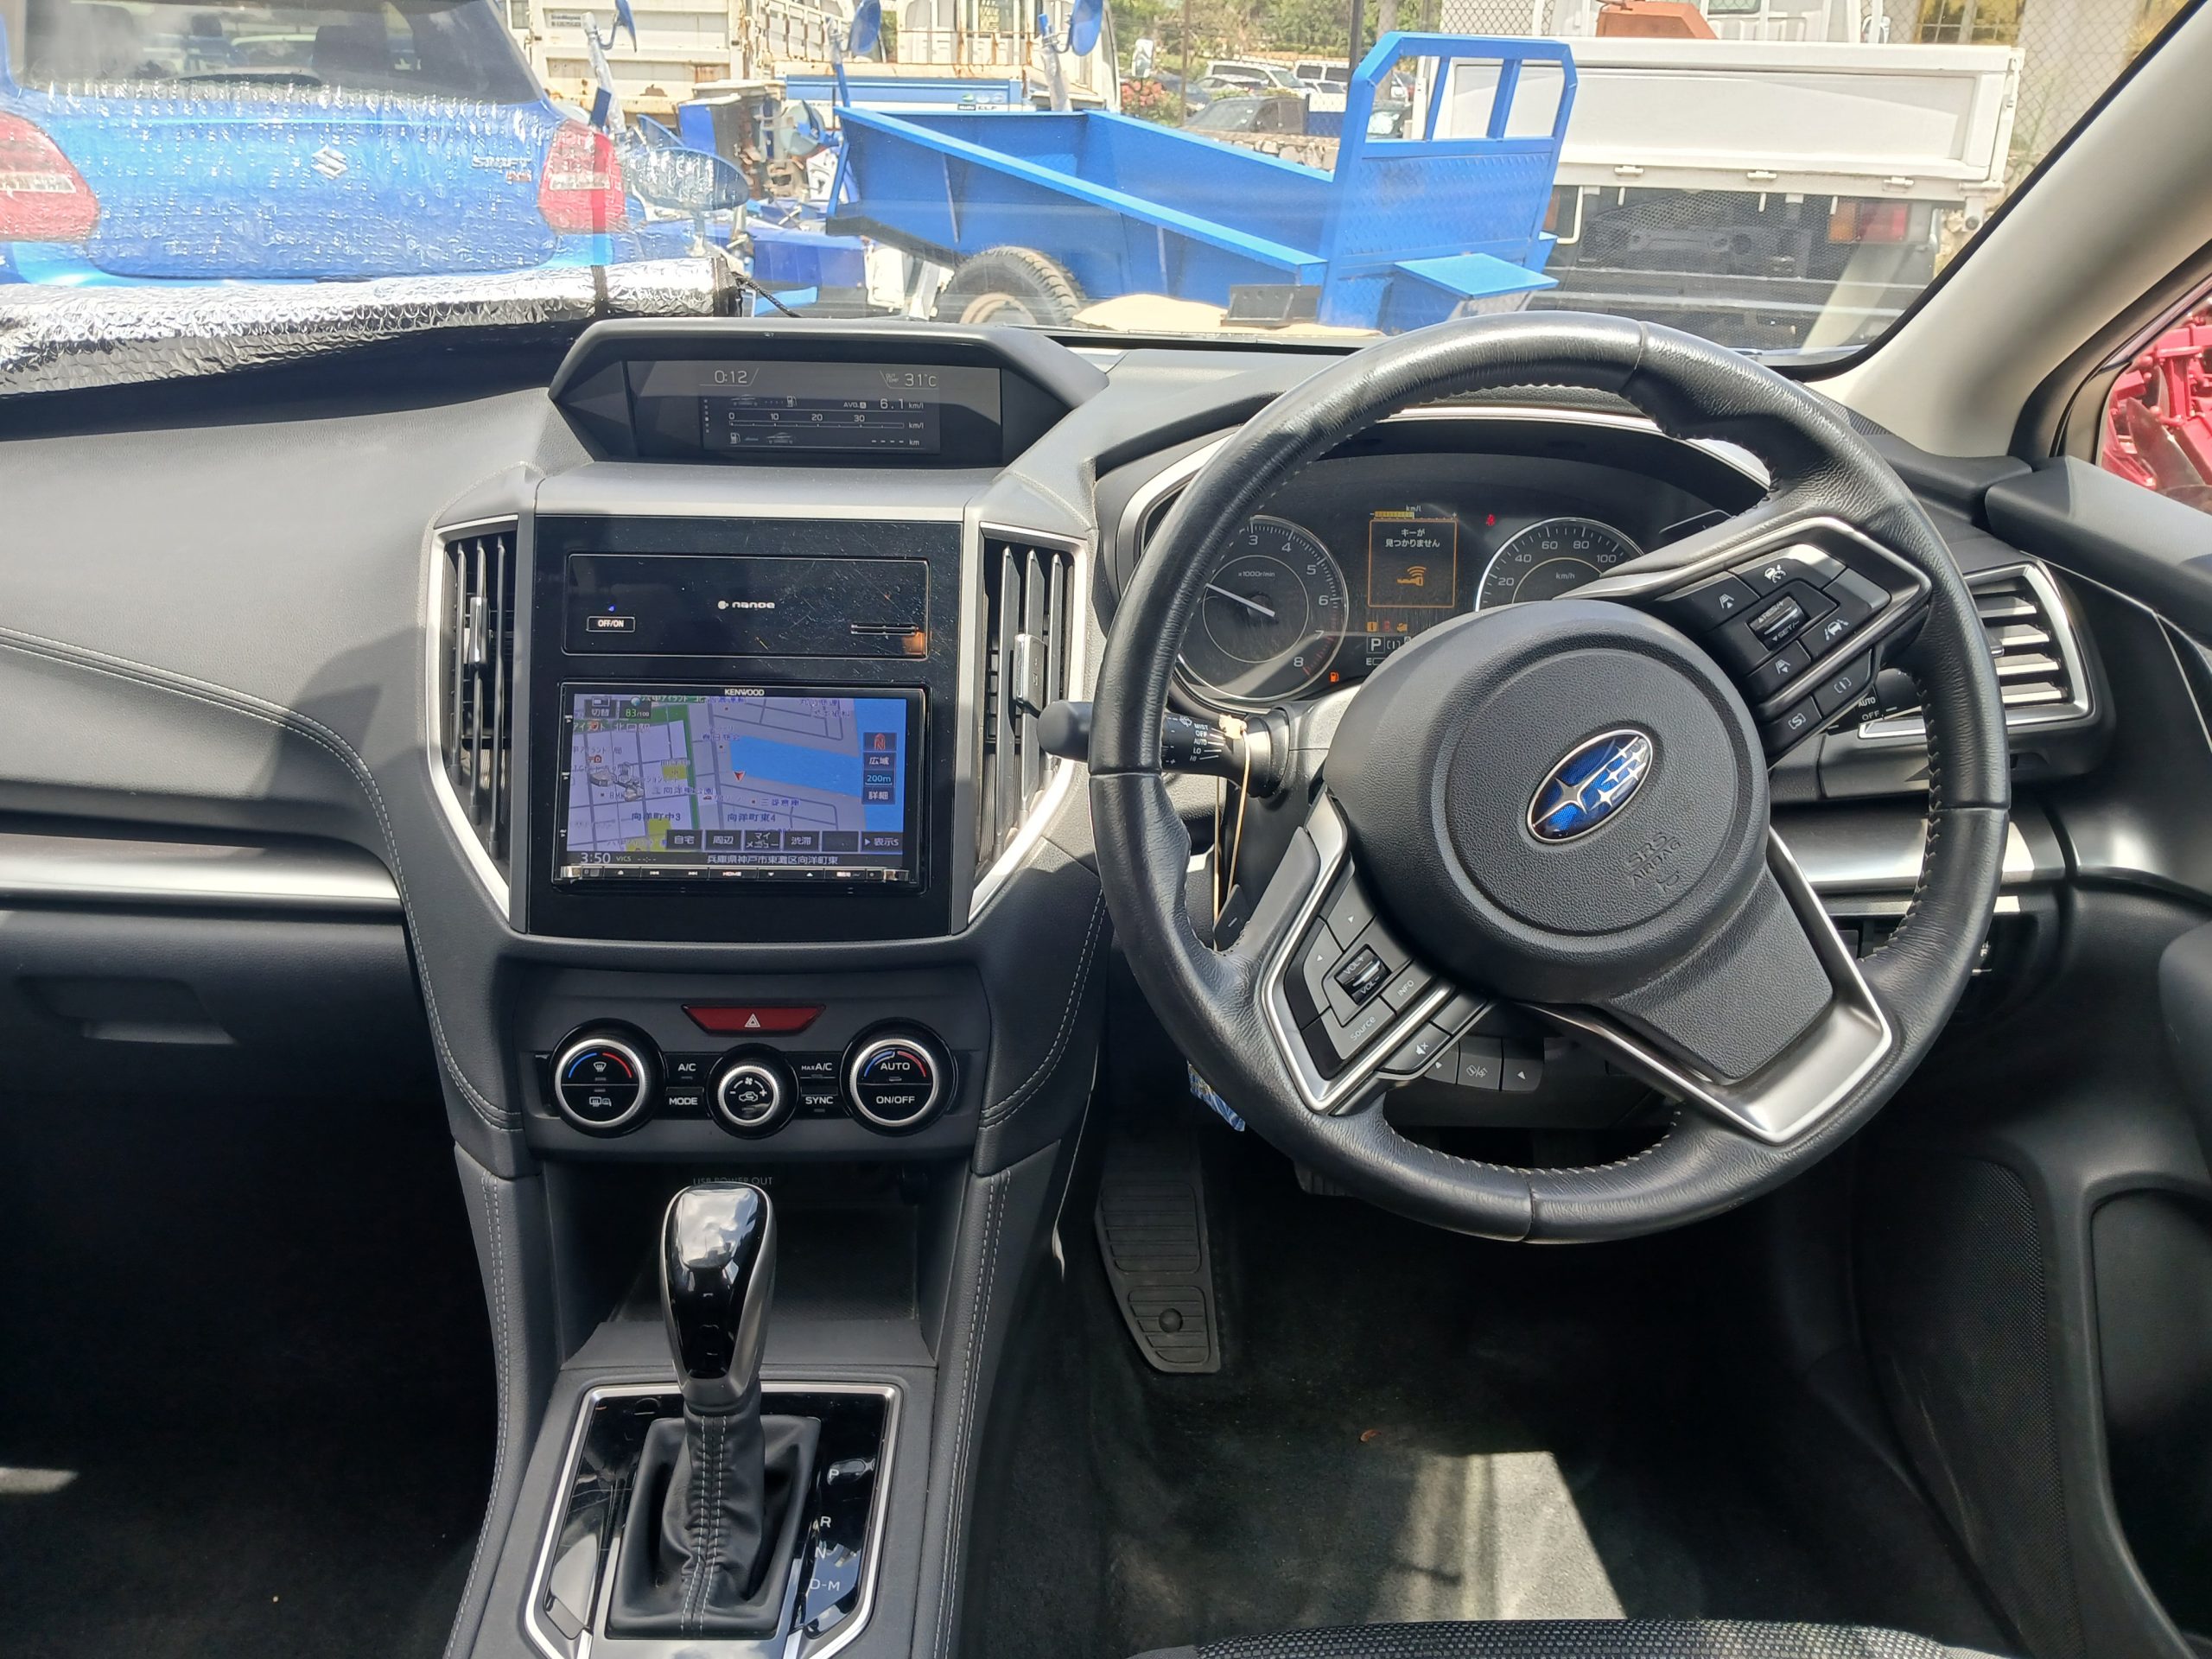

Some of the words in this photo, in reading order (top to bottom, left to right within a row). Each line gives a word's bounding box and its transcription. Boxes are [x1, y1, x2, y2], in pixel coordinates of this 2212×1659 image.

[714, 370, 748, 384] 0:12
[880, 398, 905, 410] 6.1
[1402, 528, 1426, 537] キーが
[1249, 535, 1259, 546] 3
[1385, 538, 1440, 549] 見つかりません
[1541, 540, 1559, 550] 60
[1573, 540, 1590, 550] 80
[1281, 543, 1292, 553] 4
[1515, 553, 1532, 563] 40
[1596, 553, 1617, 563] 100
[1306, 564, 1317, 575] 5
[1498, 576, 1515, 587] 20
[1319, 594, 1329, 606] 6
[598, 620, 624, 628] OFF/ON
[1314, 629, 1325, 640] 7
[1370, 638, 1382, 652] P
[1294, 656, 1304, 667] 8
[1366, 658, 1372, 666] E
[724, 688, 765, 696] KENWOOD
[1858, 696, 1877, 708] AUTO
[1861, 710, 1880, 721] OFF
[869, 756, 890, 766] 広域
[868, 791, 889, 800] 詳細
[674, 835, 695, 844] 自宅
[713, 836, 734, 845] 周辺
[791, 836, 811, 846] 渋滞
[1628, 832, 1668, 864] SRS
[581, 852, 611, 864] 3:50
[1396, 980, 1414, 997] INFO
[1350, 1016, 1376, 1041] Source
[677, 1063, 696, 1071] A/C
[880, 1062, 911, 1071] AUTO
[669, 1096, 698, 1106] MODE
[805, 1096, 834, 1105] SYNC
[875, 1096, 916, 1104] ON/OFF
[751, 1176, 773, 1186] OUT
[829, 1469, 840, 1479] P
[820, 1516, 832, 1529] R
[815, 1546, 827, 1560] N
[810, 1578, 841, 1592] D-M
